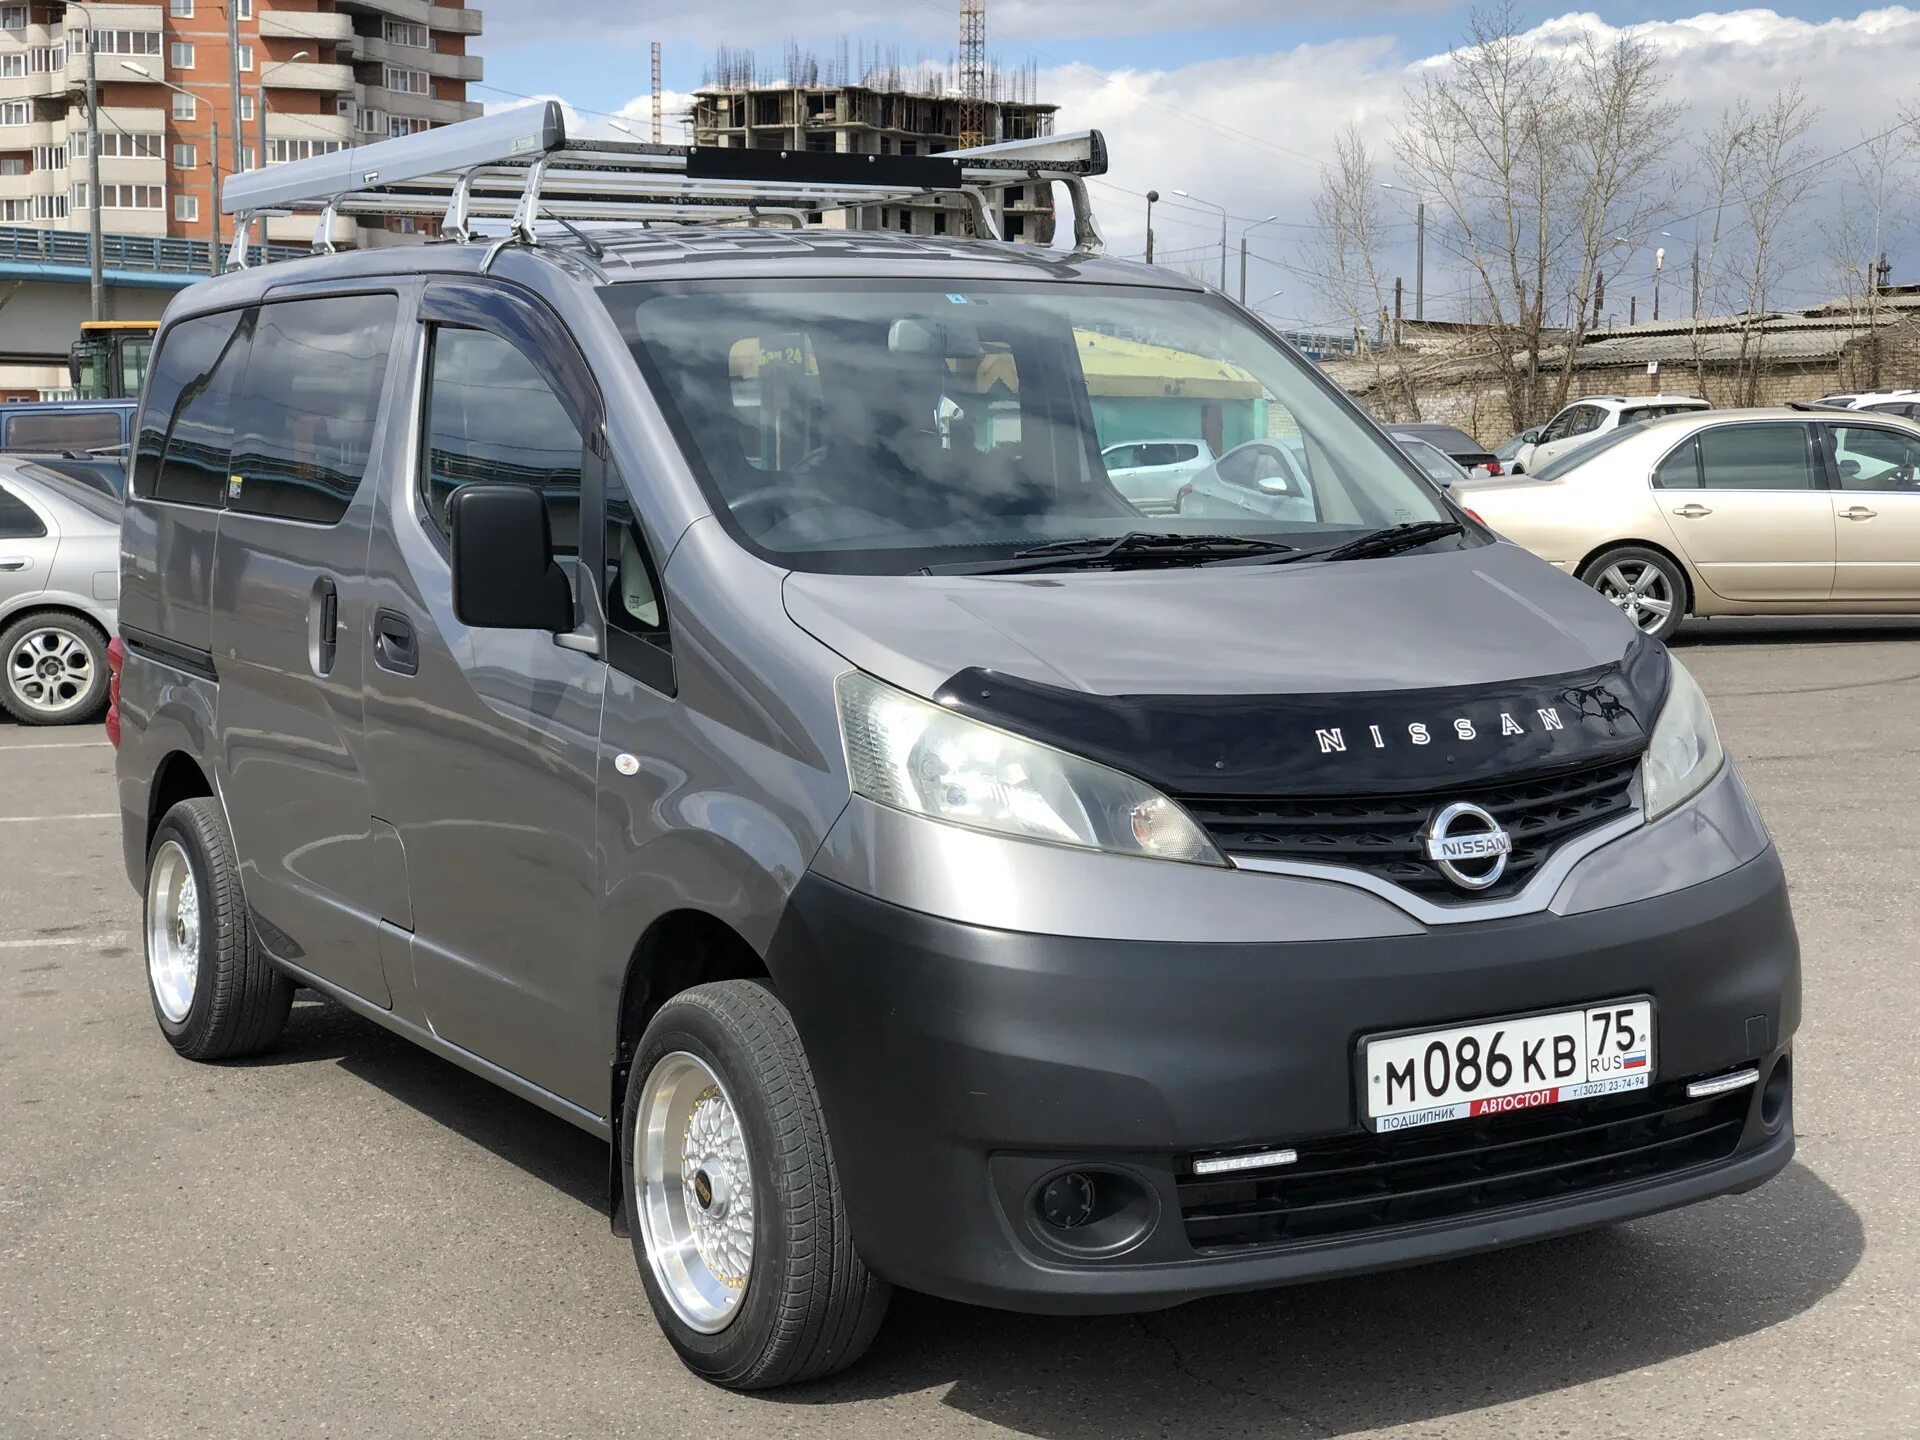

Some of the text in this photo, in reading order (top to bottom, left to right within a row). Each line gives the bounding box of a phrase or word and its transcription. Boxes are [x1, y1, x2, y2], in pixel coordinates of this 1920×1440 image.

[1316, 708, 1564, 752] NISSAN
[1441, 836, 1507, 857] NISSAN
[1591, 1009, 1636, 1056] 75
[1590, 1055, 1622, 1074] RUS
[1608, 1076, 1645, 1092] 23-74-94
[1479, 1091, 1550, 1115] АВТОСТОП
[1383, 1107, 1456, 1130] ПОДШИПНИК
